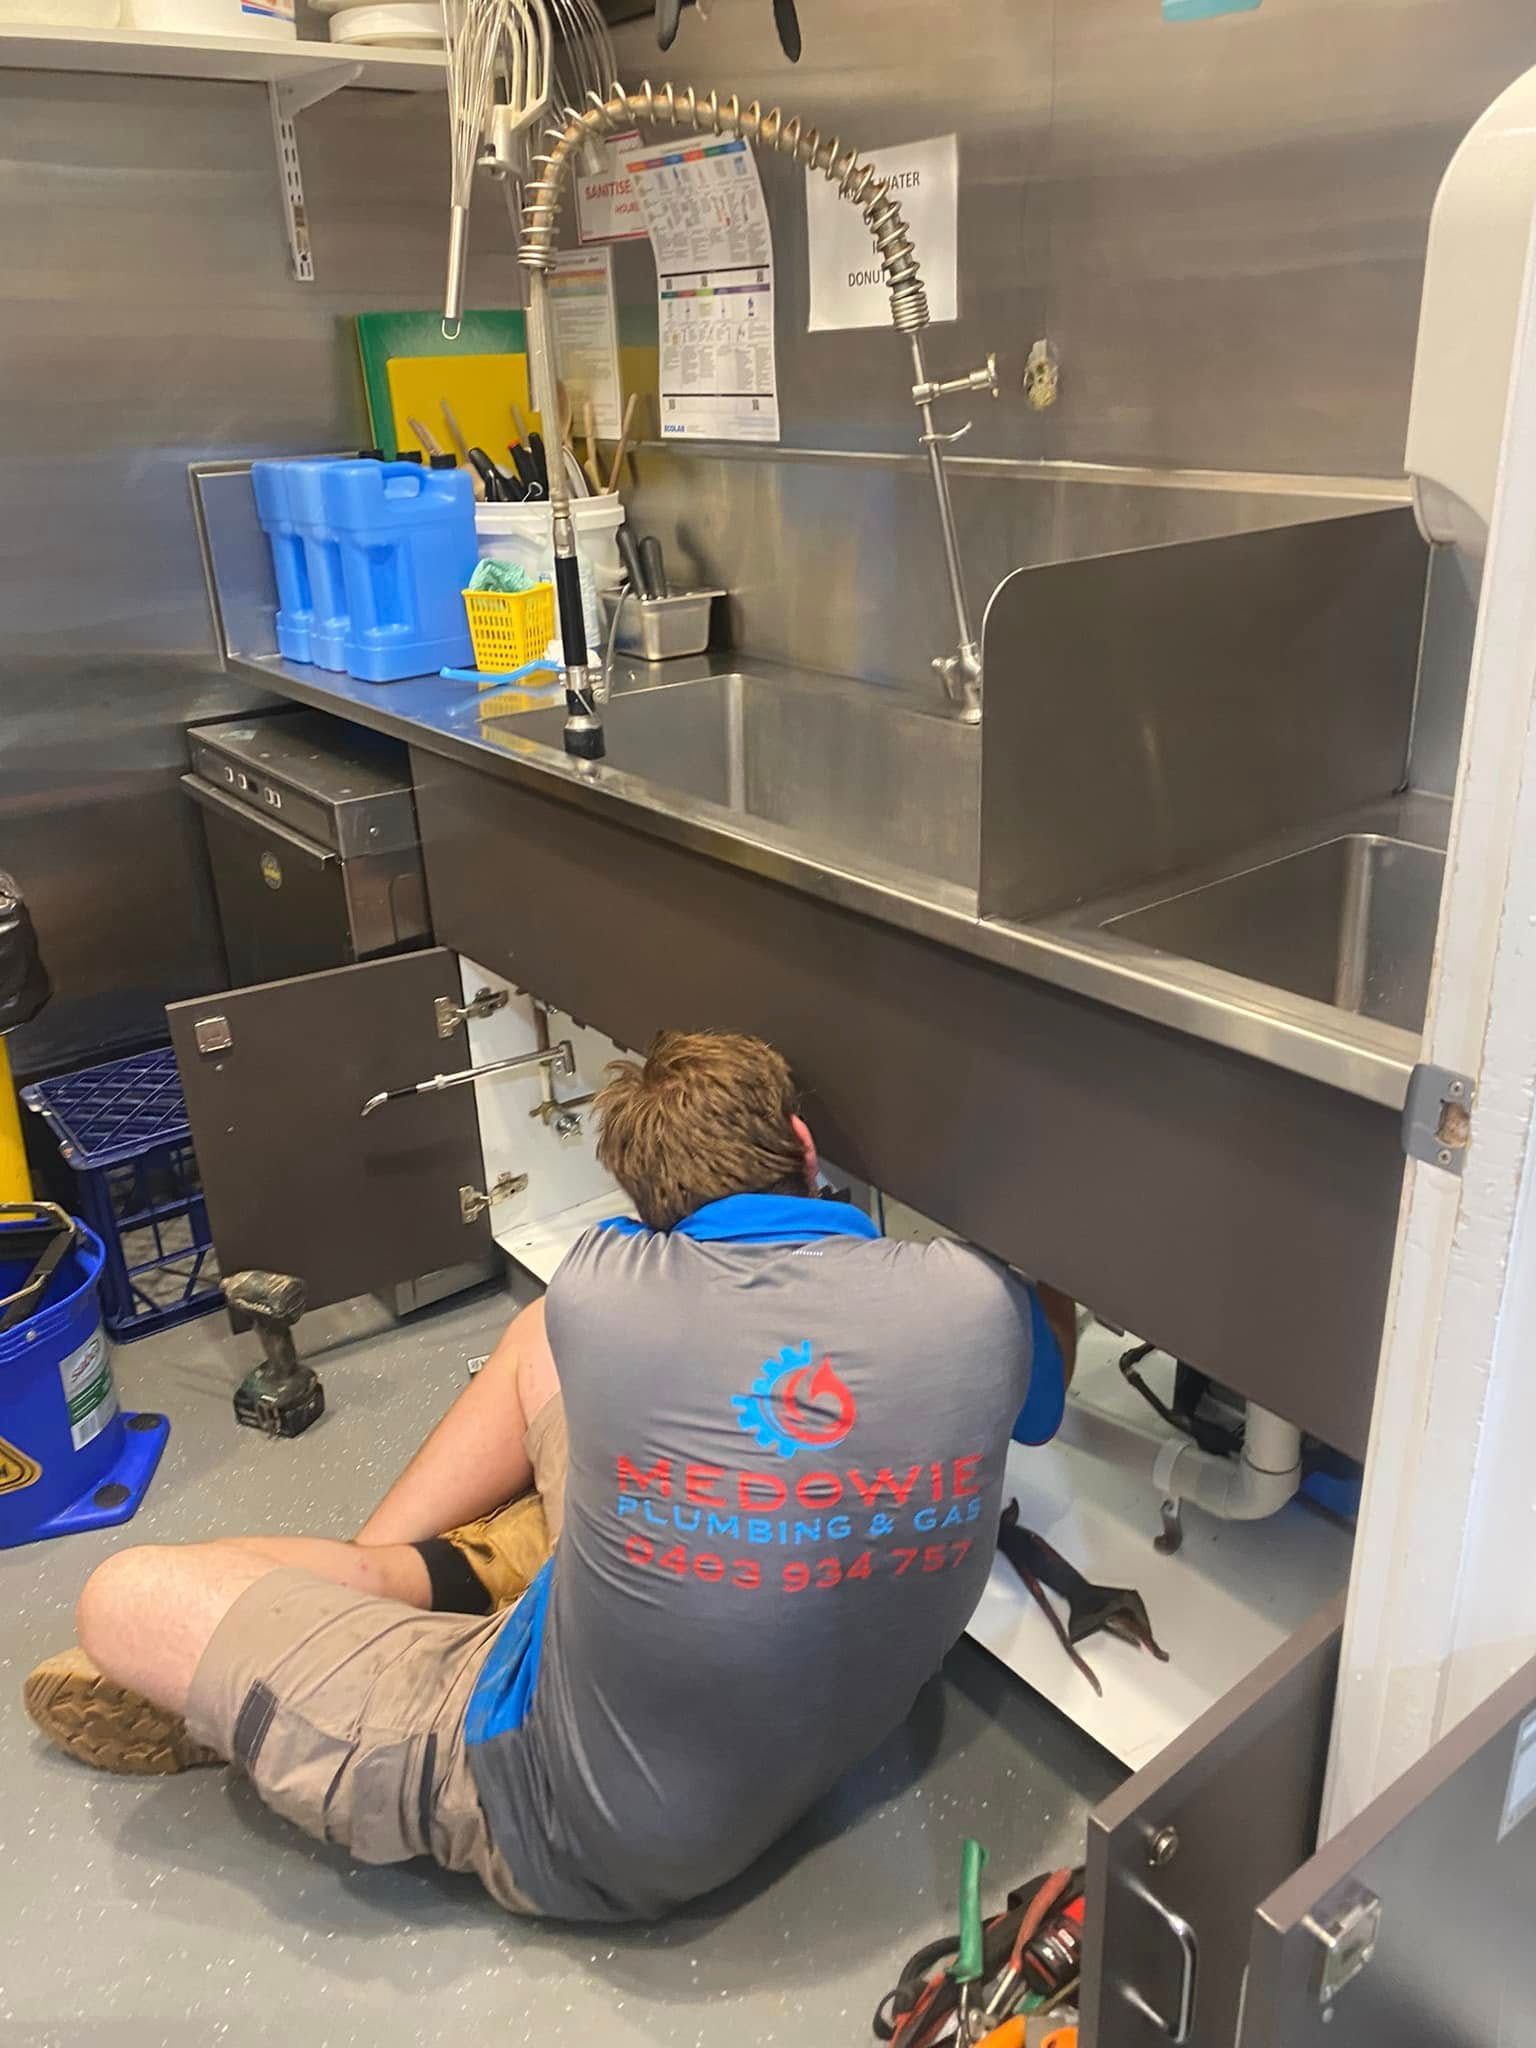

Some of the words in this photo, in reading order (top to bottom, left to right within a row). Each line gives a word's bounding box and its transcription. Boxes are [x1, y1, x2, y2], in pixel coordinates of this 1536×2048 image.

[617, 1453, 984, 1512] MEDOWIE
[617, 1495, 851, 1545] PLUMBING
[868, 1512, 896, 1536] &
[913, 1497, 981, 1532] GAS
[625, 1535, 761, 1589] 0403
[782, 1551, 873, 1593] 934
[891, 1537, 972, 1577] 757
